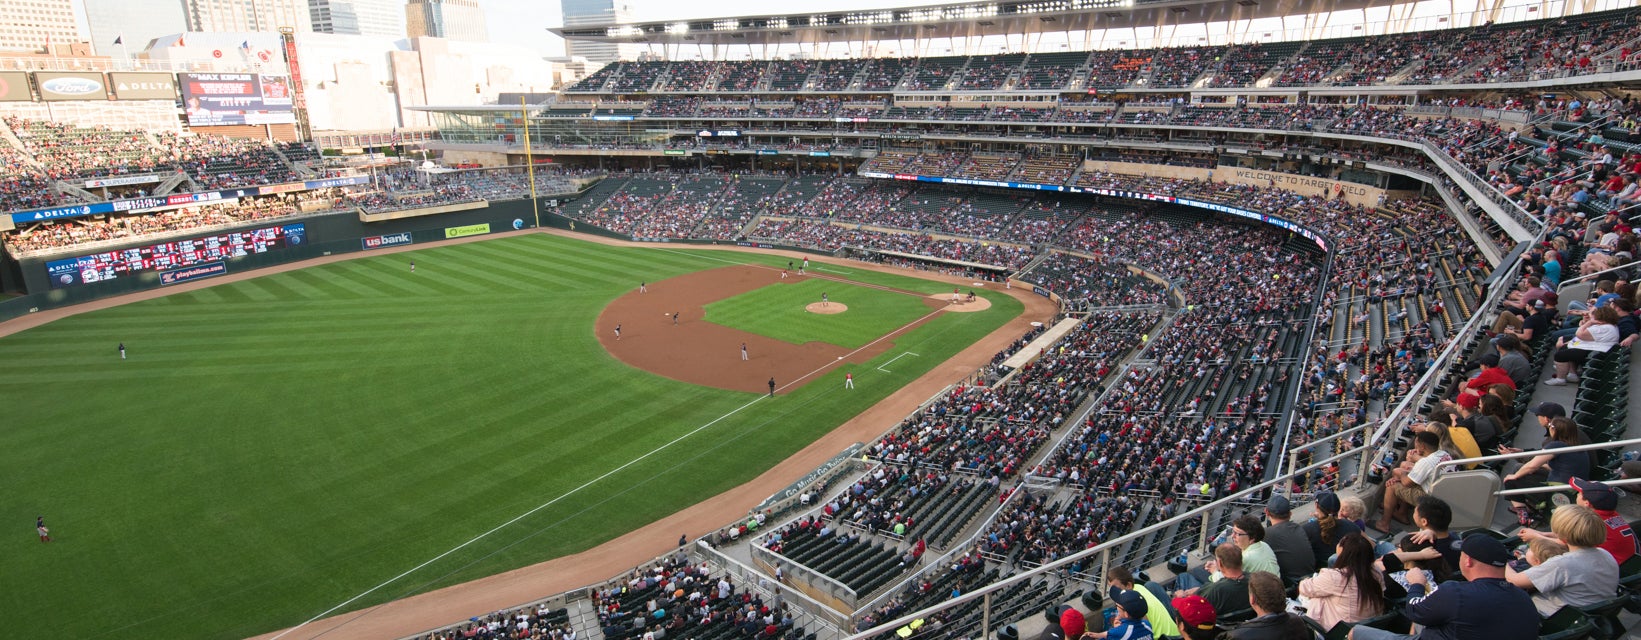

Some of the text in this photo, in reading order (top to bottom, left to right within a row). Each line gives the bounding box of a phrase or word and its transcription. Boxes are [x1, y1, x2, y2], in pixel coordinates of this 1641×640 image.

[55, 82, 90, 93] Ford
[131, 82, 173, 90] DELTA
[327, 179, 347, 187] DELTA
[1236, 170, 1366, 196] WELCOME TO TARGET FIELD
[44, 208, 77, 218] DELTA
[458, 226, 487, 235] CenturyLink
[55, 262, 79, 271] DELTA
[176, 265, 224, 280] playballmn.com
[785, 488, 798, 498] Go
[797, 473, 818, 490] Music
[817, 468, 828, 477] Go
